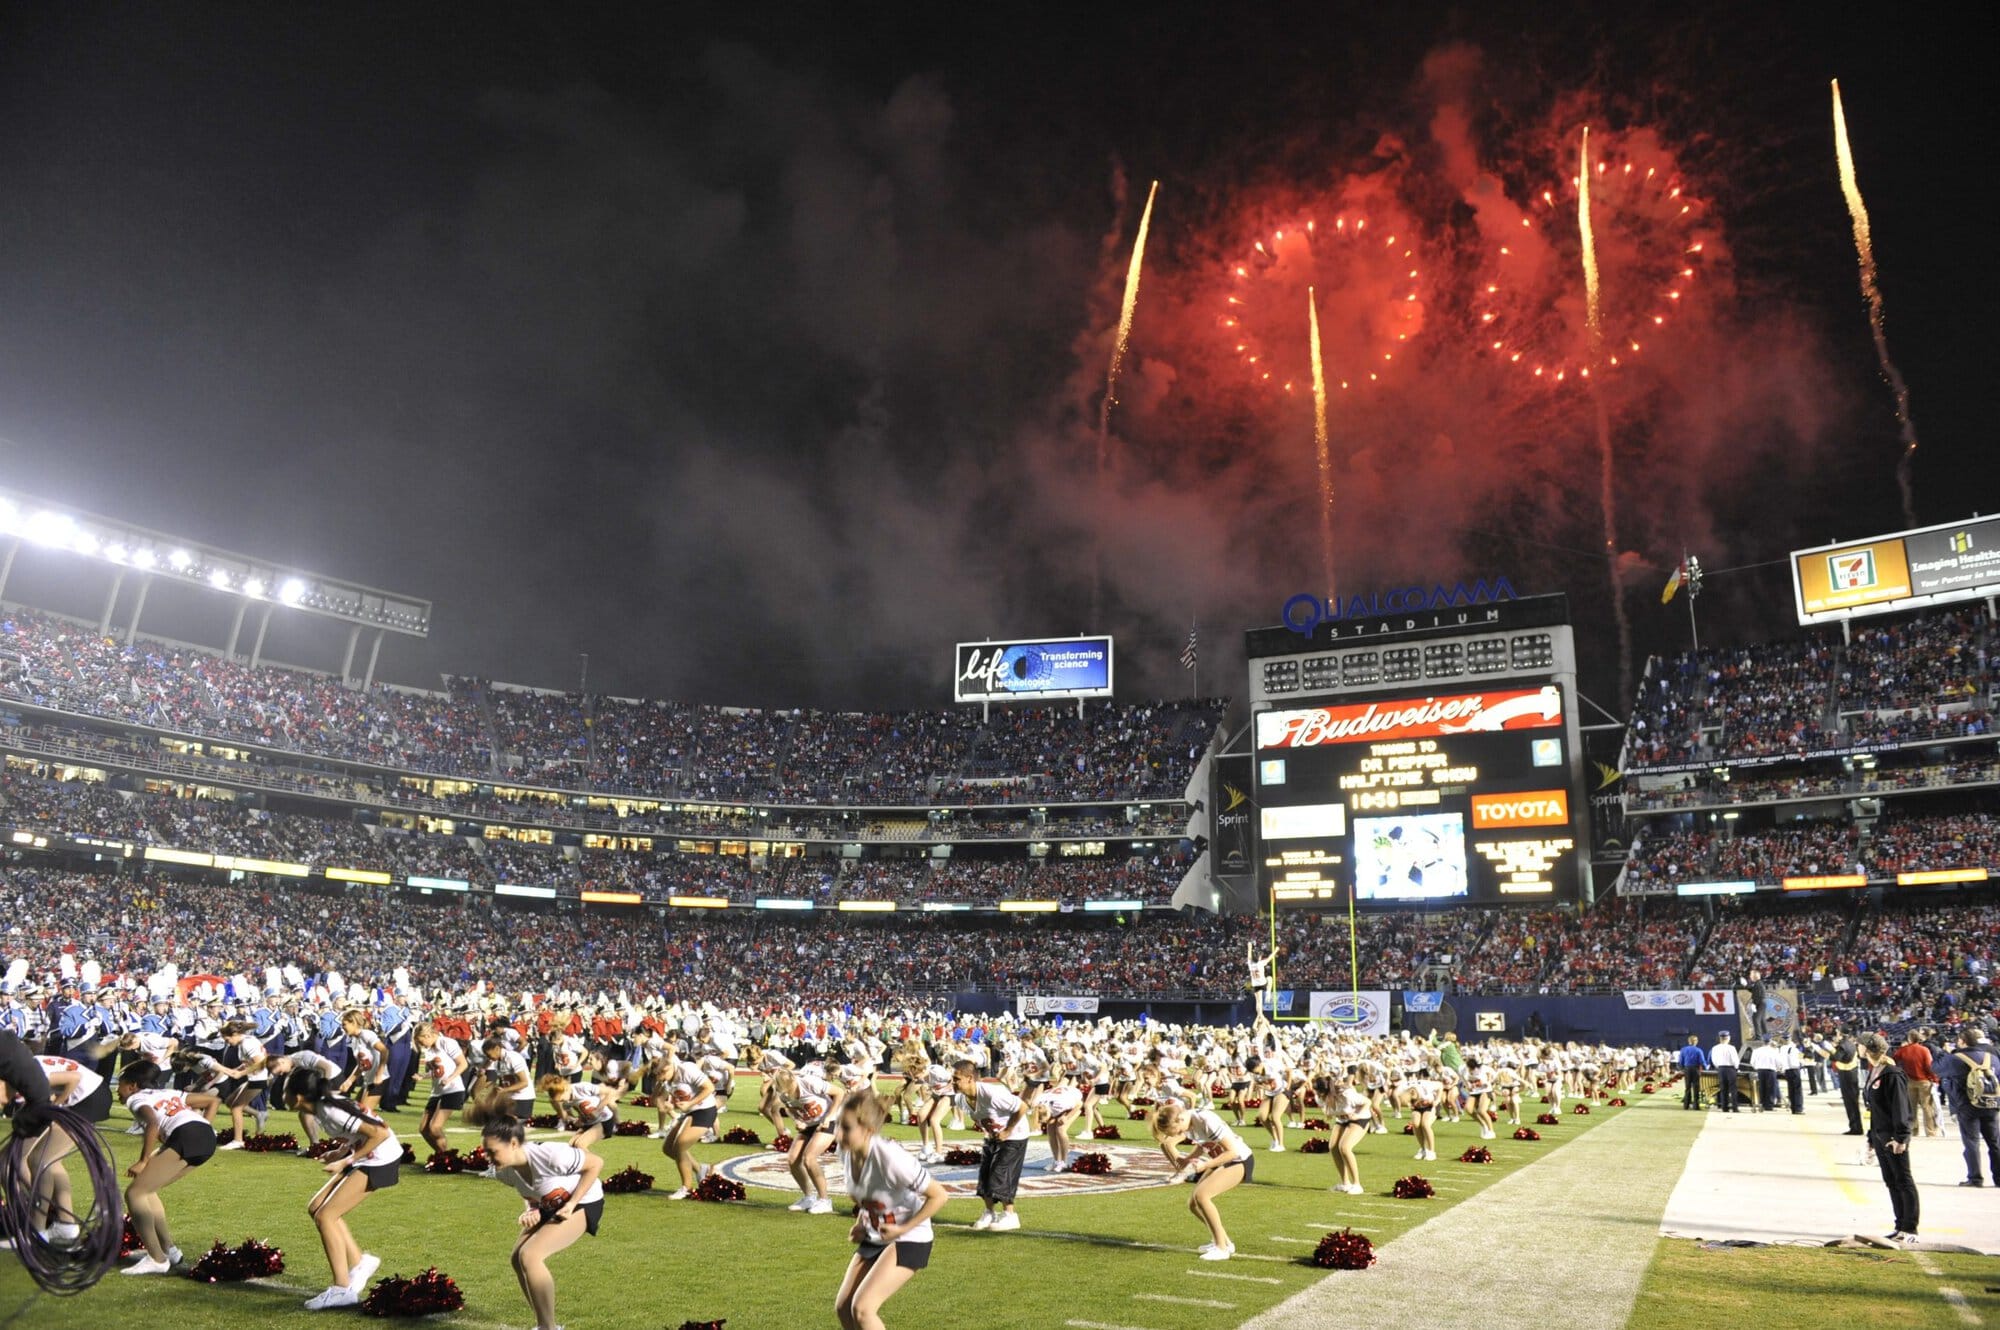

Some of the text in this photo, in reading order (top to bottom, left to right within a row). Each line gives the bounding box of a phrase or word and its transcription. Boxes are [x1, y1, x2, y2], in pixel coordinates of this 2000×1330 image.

[1911, 558, 1959, 572] Imaging
[1281, 576, 1517, 639] QUALCOMM
[1330, 609, 1499, 639] STADIUM
[1041, 650, 1103, 661] Transforming
[1054, 660, 1089, 669] science
[959, 648, 1010, 692] life
[1286, 696, 1483, 747] Budweiser
[1420, 741, 1437, 752] TO
[1361, 753, 1448, 772] DR PEPPER
[1476, 800, 1563, 821] TOYOTA
[1218, 813, 1249, 828] Sprint
[1024, 998, 1040, 1014] A
[1702, 992, 1726, 1012] N
